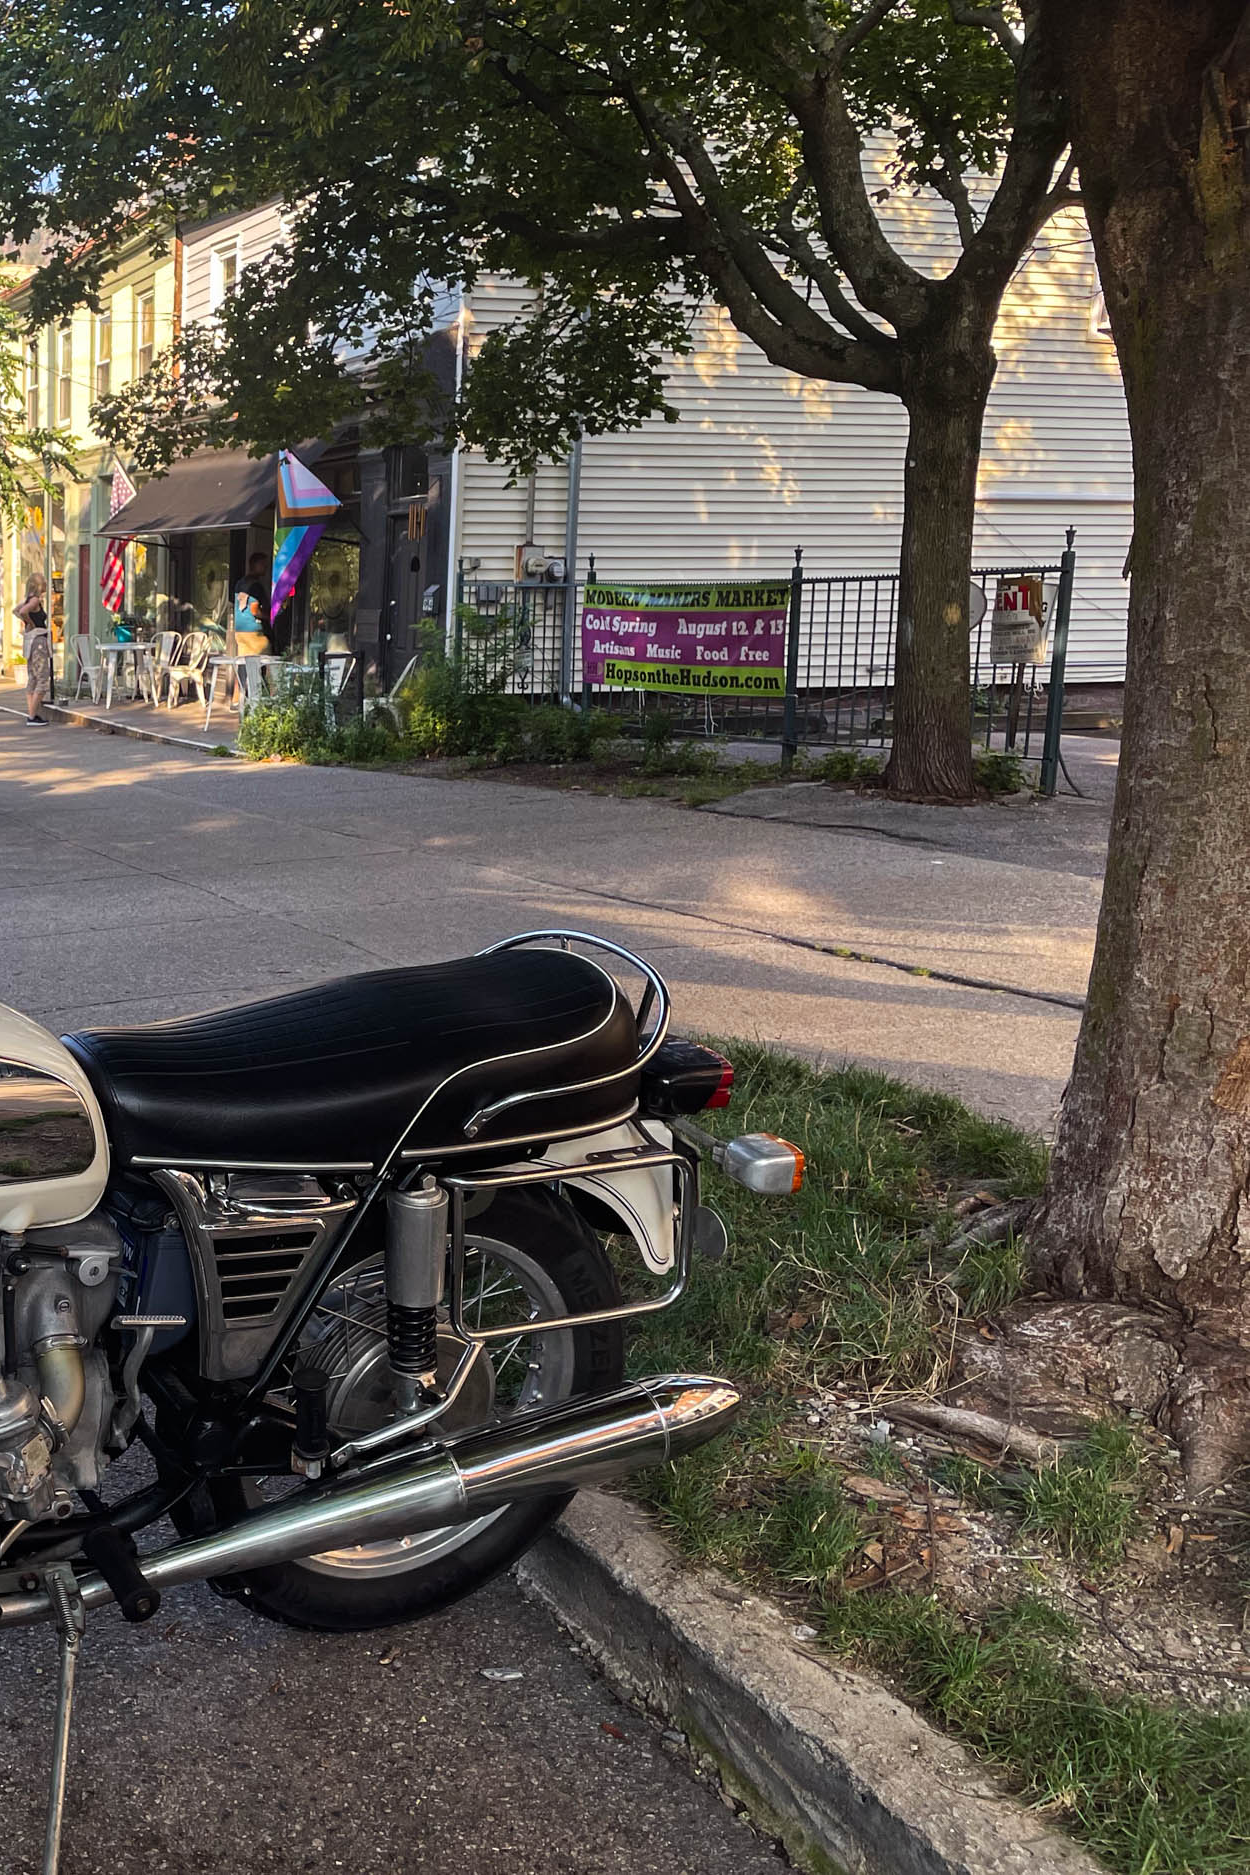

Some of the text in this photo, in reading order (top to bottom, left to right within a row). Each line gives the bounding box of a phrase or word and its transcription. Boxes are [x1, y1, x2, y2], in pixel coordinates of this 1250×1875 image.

[585, 588, 789, 608] MODERN MAKERS MARKET
[585, 614, 785, 639] Cold Spring August 12 & 13
[593, 640, 770, 661] Artisans Music Food Free
[605, 662, 781, 690] HopsontheHudson.com
